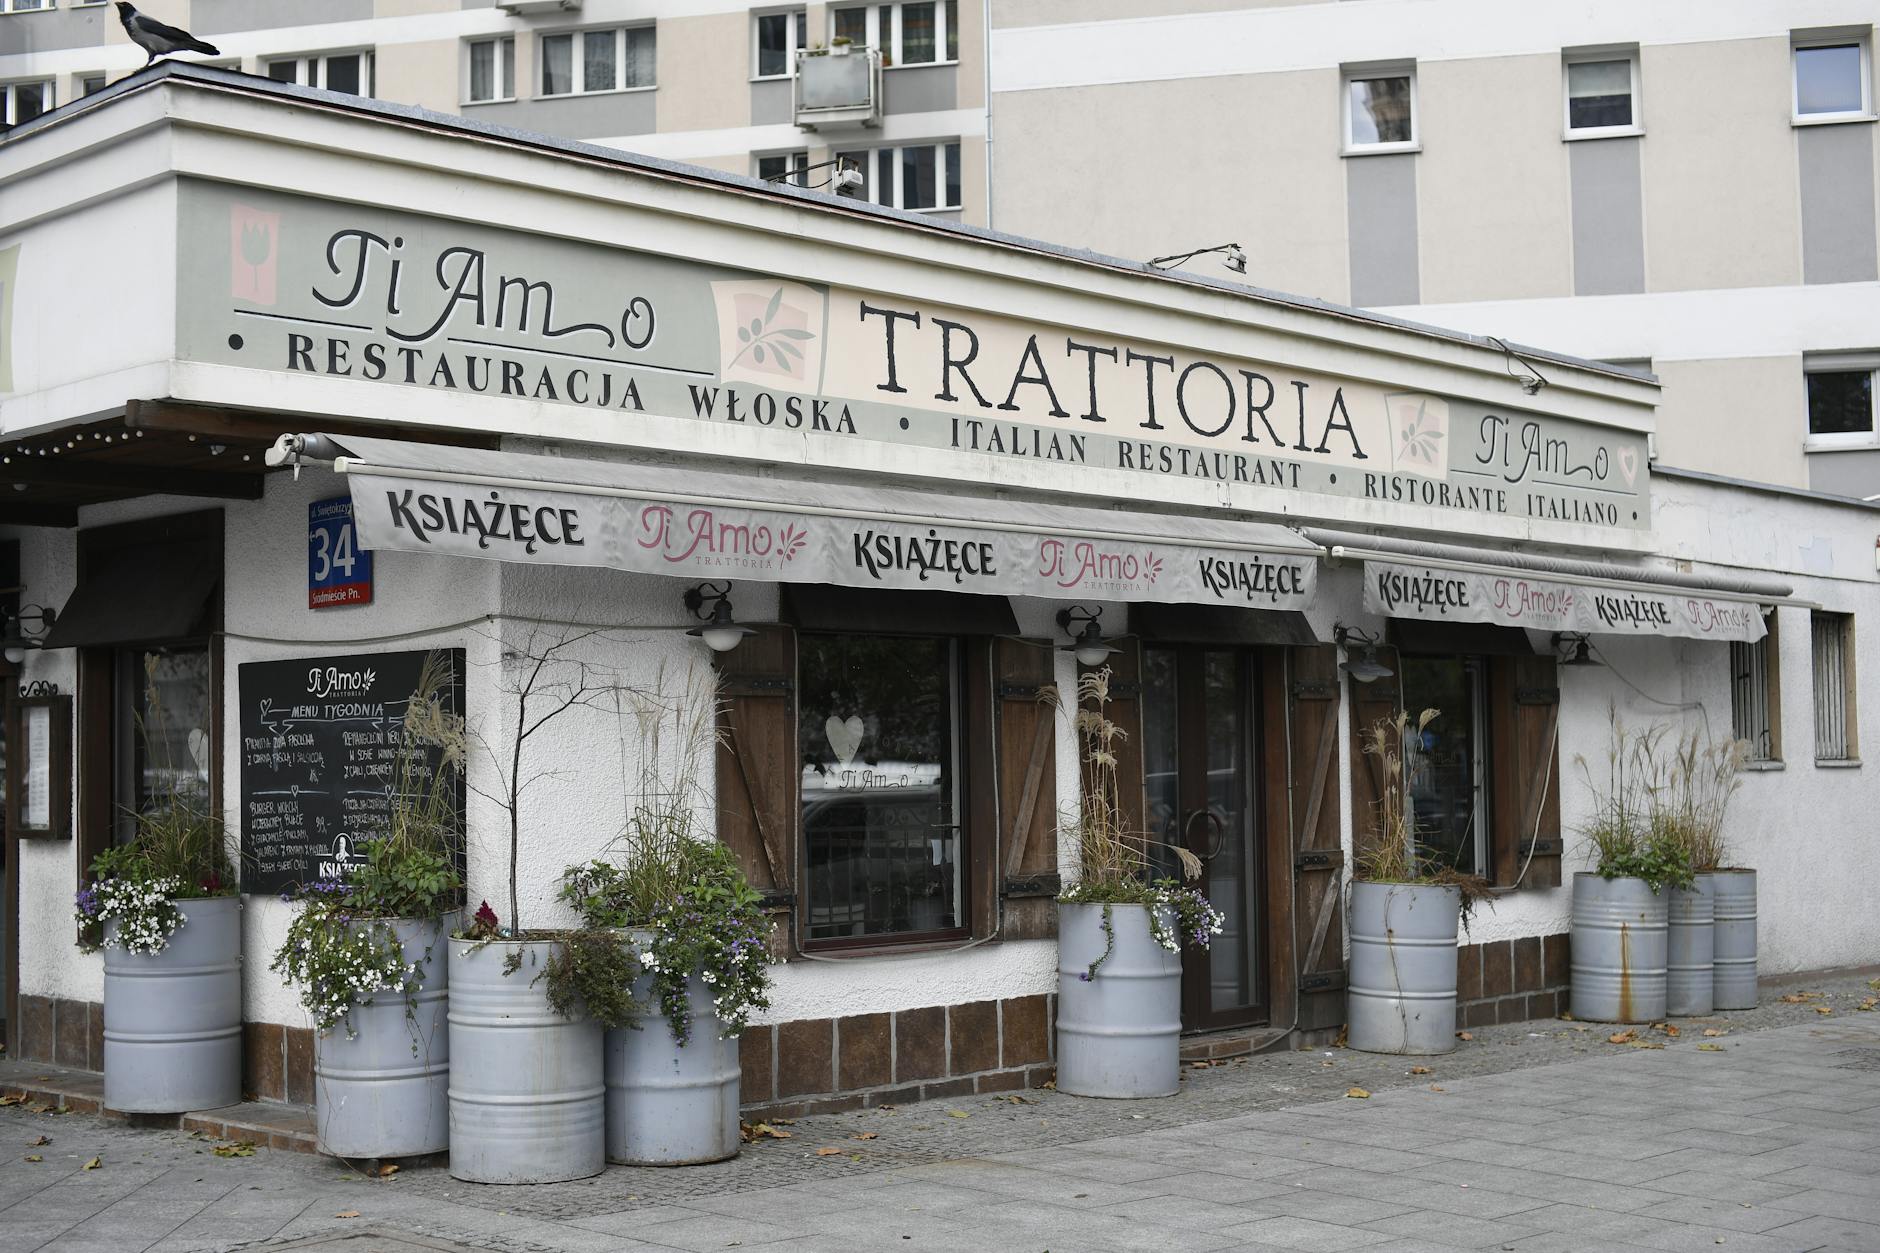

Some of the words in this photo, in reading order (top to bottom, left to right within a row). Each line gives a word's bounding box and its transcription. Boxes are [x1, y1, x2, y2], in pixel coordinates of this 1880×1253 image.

[312, 229, 404, 315] Ti
[385, 246, 655, 350] Amo
[287, 333, 645, 410] RESTAURACJA
[688, 384, 857, 434] WŁOSKA
[860, 300, 1368, 460] TRATTORIA
[952, 418, 1087, 463] ITALIAN
[1118, 440, 1301, 488] RESTAURANT
[1476, 415, 1509, 466] Ti
[1503, 423, 1609, 484] Amo
[387, 490, 585, 555] KSIĄŻĘCE
[1364, 474, 1507, 512] RISTORANTE
[1527, 495, 1618, 525] ITALIANO
[315, 524, 355, 581] 34
[638, 506, 672, 550] Ti
[663, 509, 772, 563] Amo
[853, 529, 996, 584] KSIĄŻĘCE
[696, 556, 772, 569] TRATTORIA
[1038, 540, 1064, 578] Ti
[1057, 544, 1138, 587] Amo
[1083, 581, 1141, 591] TRATTORIA
[1199, 555, 1305, 603] KSIĄŻĘCE
[312, 589, 346, 604] Śródmieście
[348, 588, 360, 600] Pn.
[1379, 570, 1469, 613] KSIĄŻĘCE
[1494, 579, 1510, 610] Ti
[1506, 581, 1556, 617] Amo
[1595, 594, 1671, 628] KSIĄŻĘCE
[307, 668, 321, 692] Ti
[316, 667, 361, 698] Amo
[291, 705, 318, 718] MENU
[325, 703, 384, 719] TYGODNIA
[840, 770, 857, 789] Ti
[249, 801, 275, 816] BURGER
